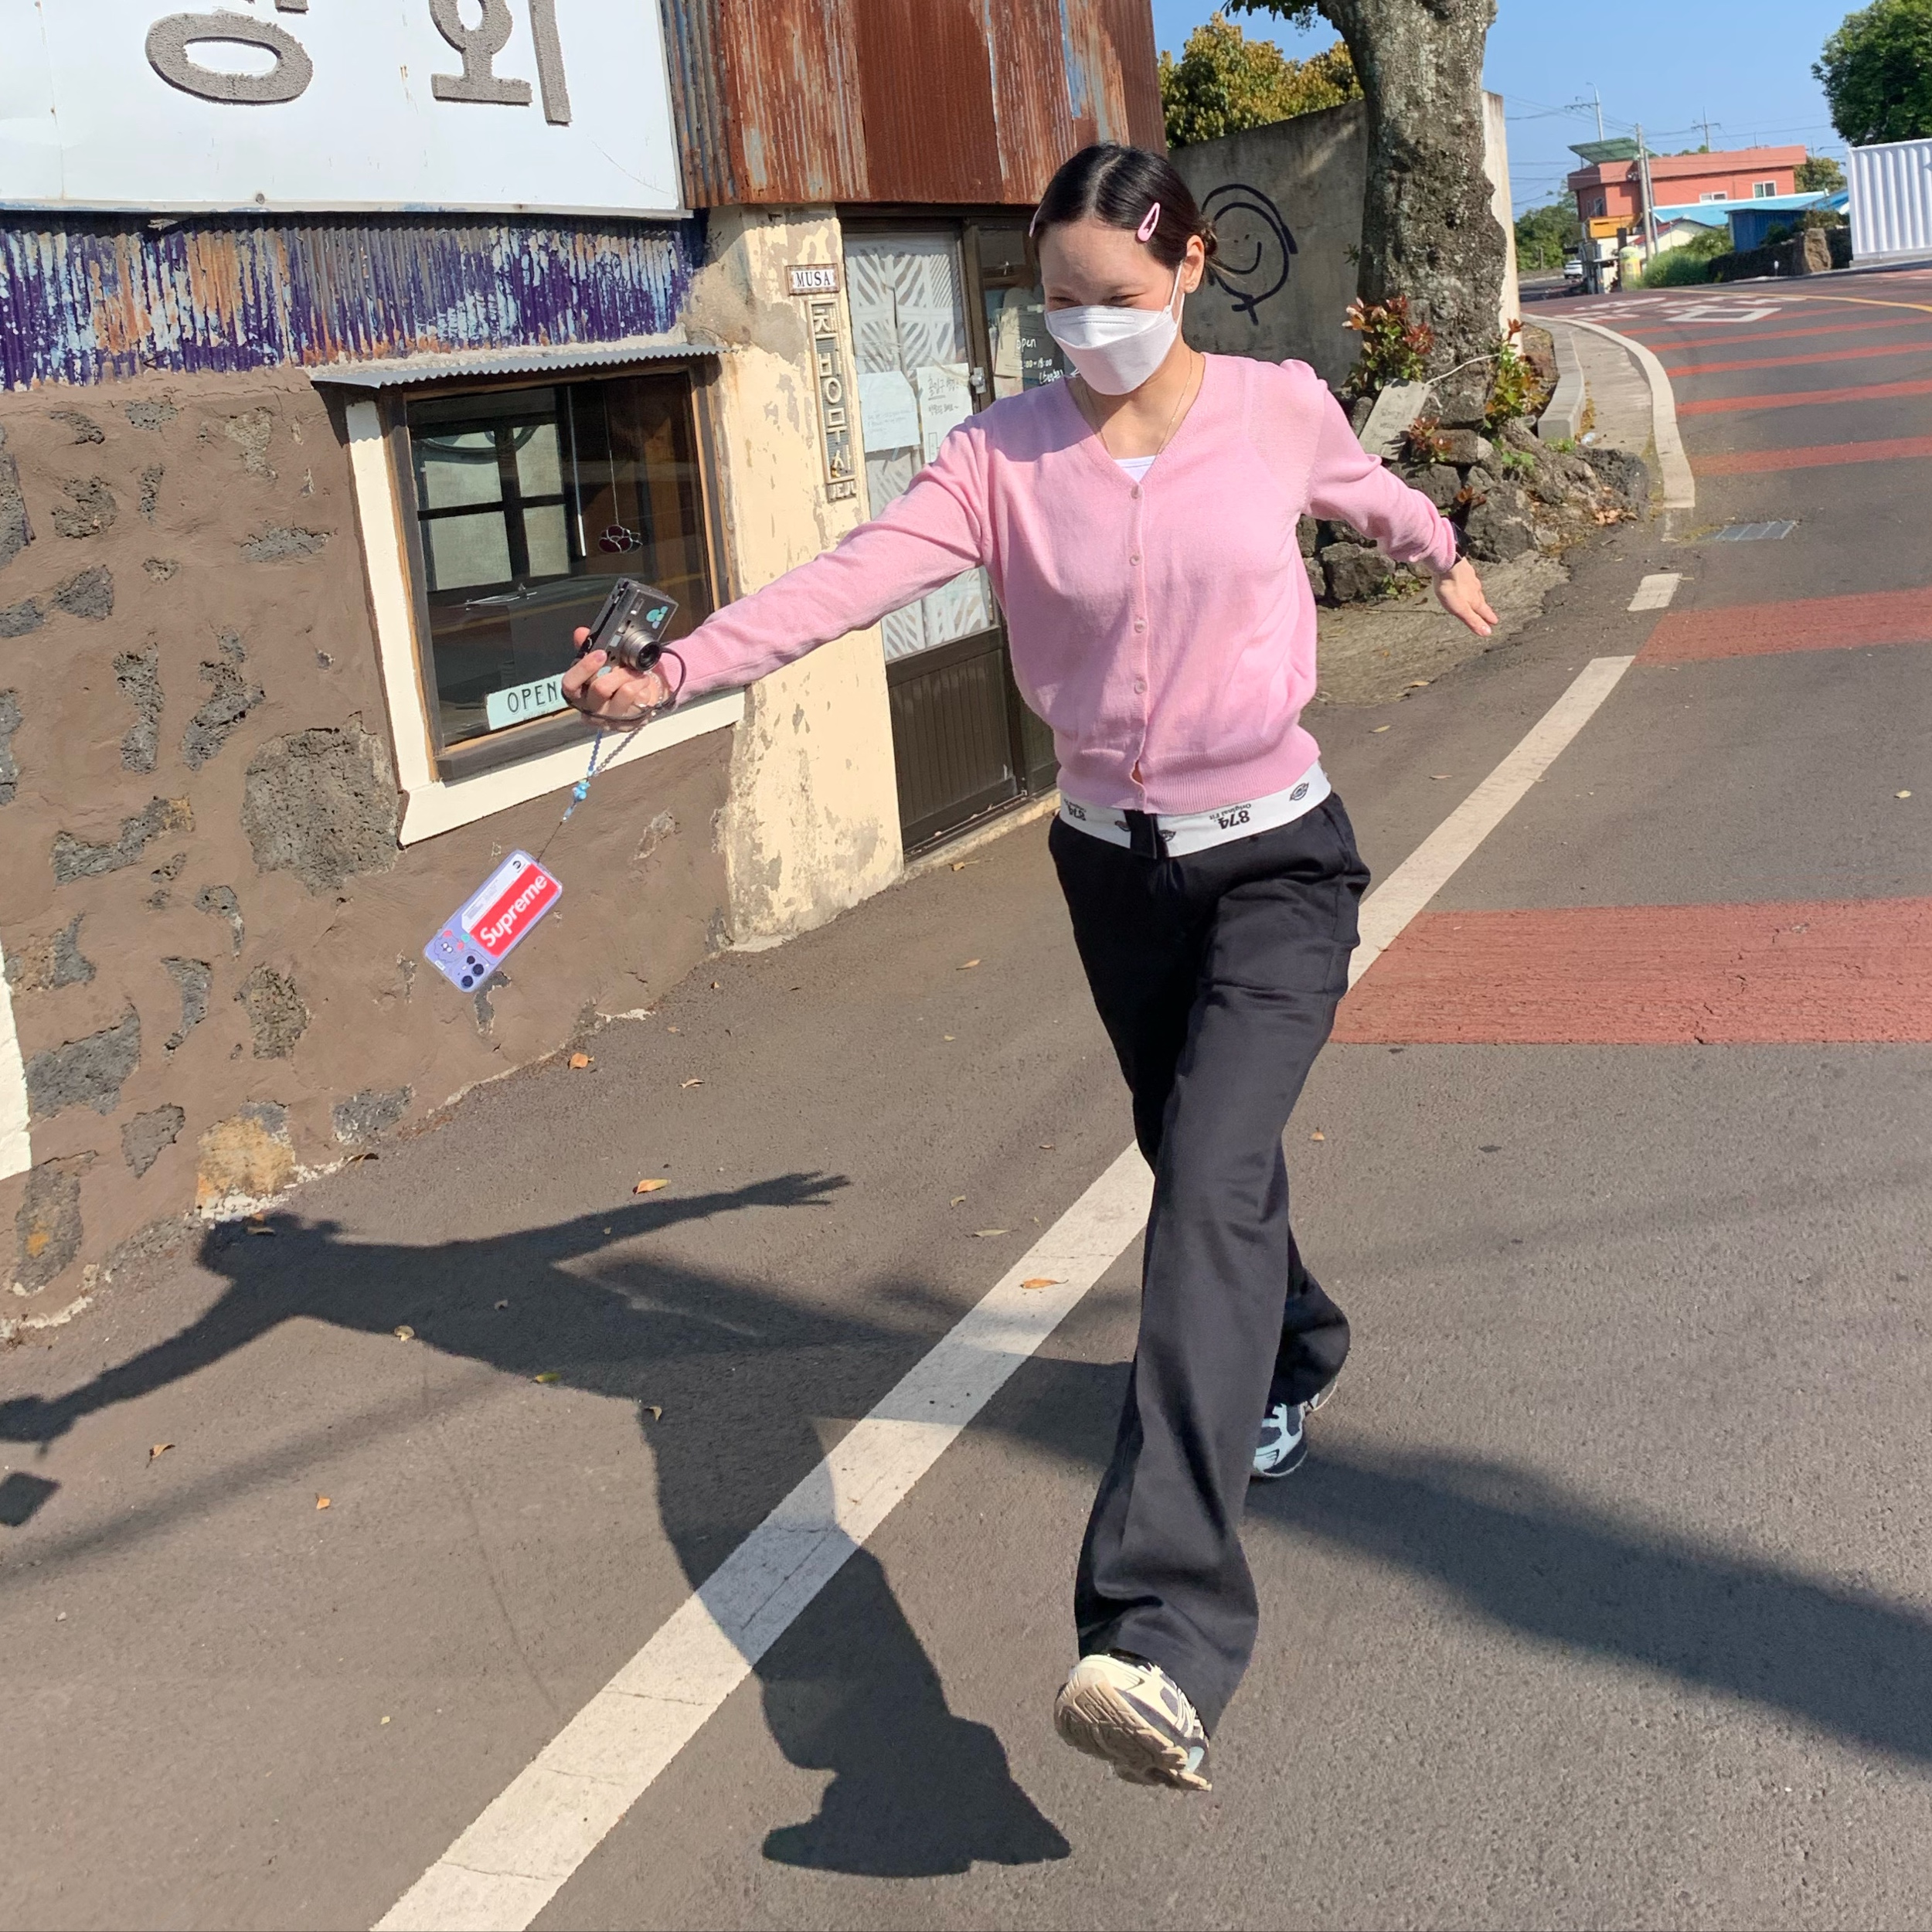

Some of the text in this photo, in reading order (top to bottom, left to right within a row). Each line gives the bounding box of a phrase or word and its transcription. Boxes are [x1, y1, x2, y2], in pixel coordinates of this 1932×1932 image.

[796, 271, 831, 287] MUSA
[813, 308, 852, 478] 책방무사
[508, 681, 558, 713] OPEN
[1209, 803, 1252, 822] Original Fit
[1218, 810, 1250, 829] 874
[480, 875, 547, 947] Supreme
